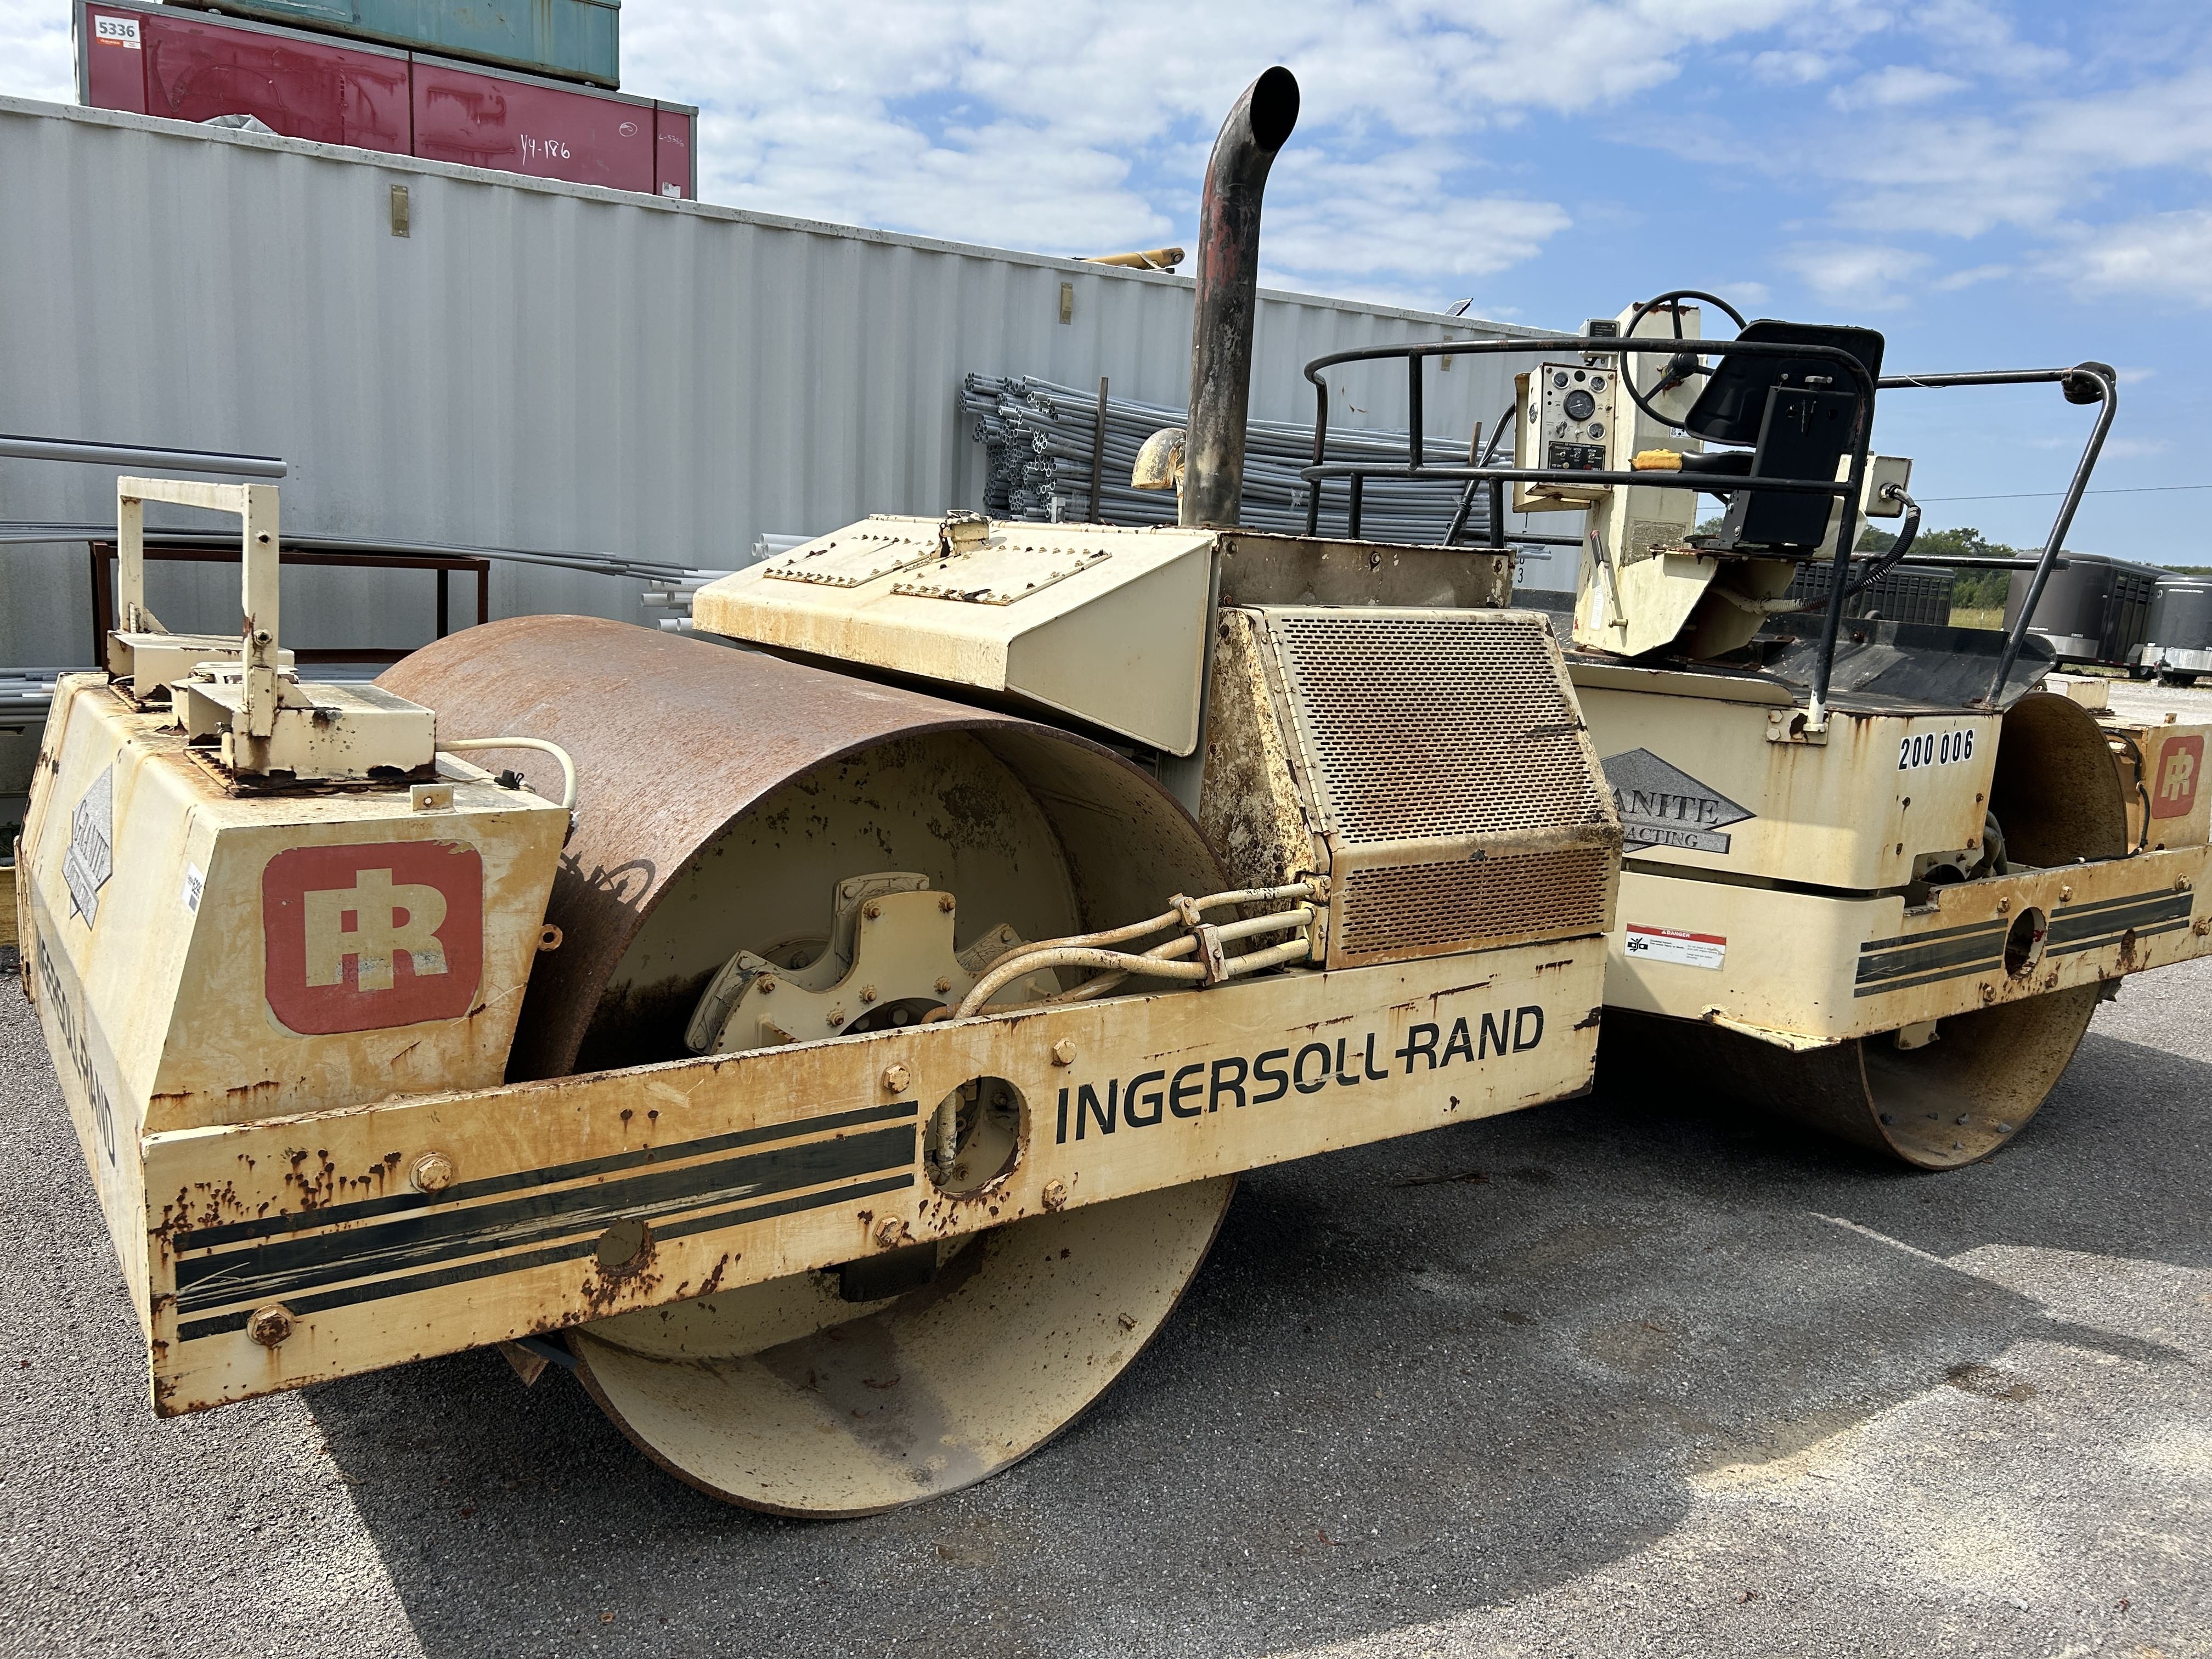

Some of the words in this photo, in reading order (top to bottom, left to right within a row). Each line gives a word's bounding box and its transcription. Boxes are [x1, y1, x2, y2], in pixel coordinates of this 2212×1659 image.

[99, 21, 135, 37] 5336
[1899, 734, 1934, 770] 200
[1940, 729, 1973, 764] 006
[1612, 787, 1719, 825] ANITE
[1626, 826, 1699, 848] ACTING
[1056, 1005, 1544, 1145] INGERSOLL-RAND
